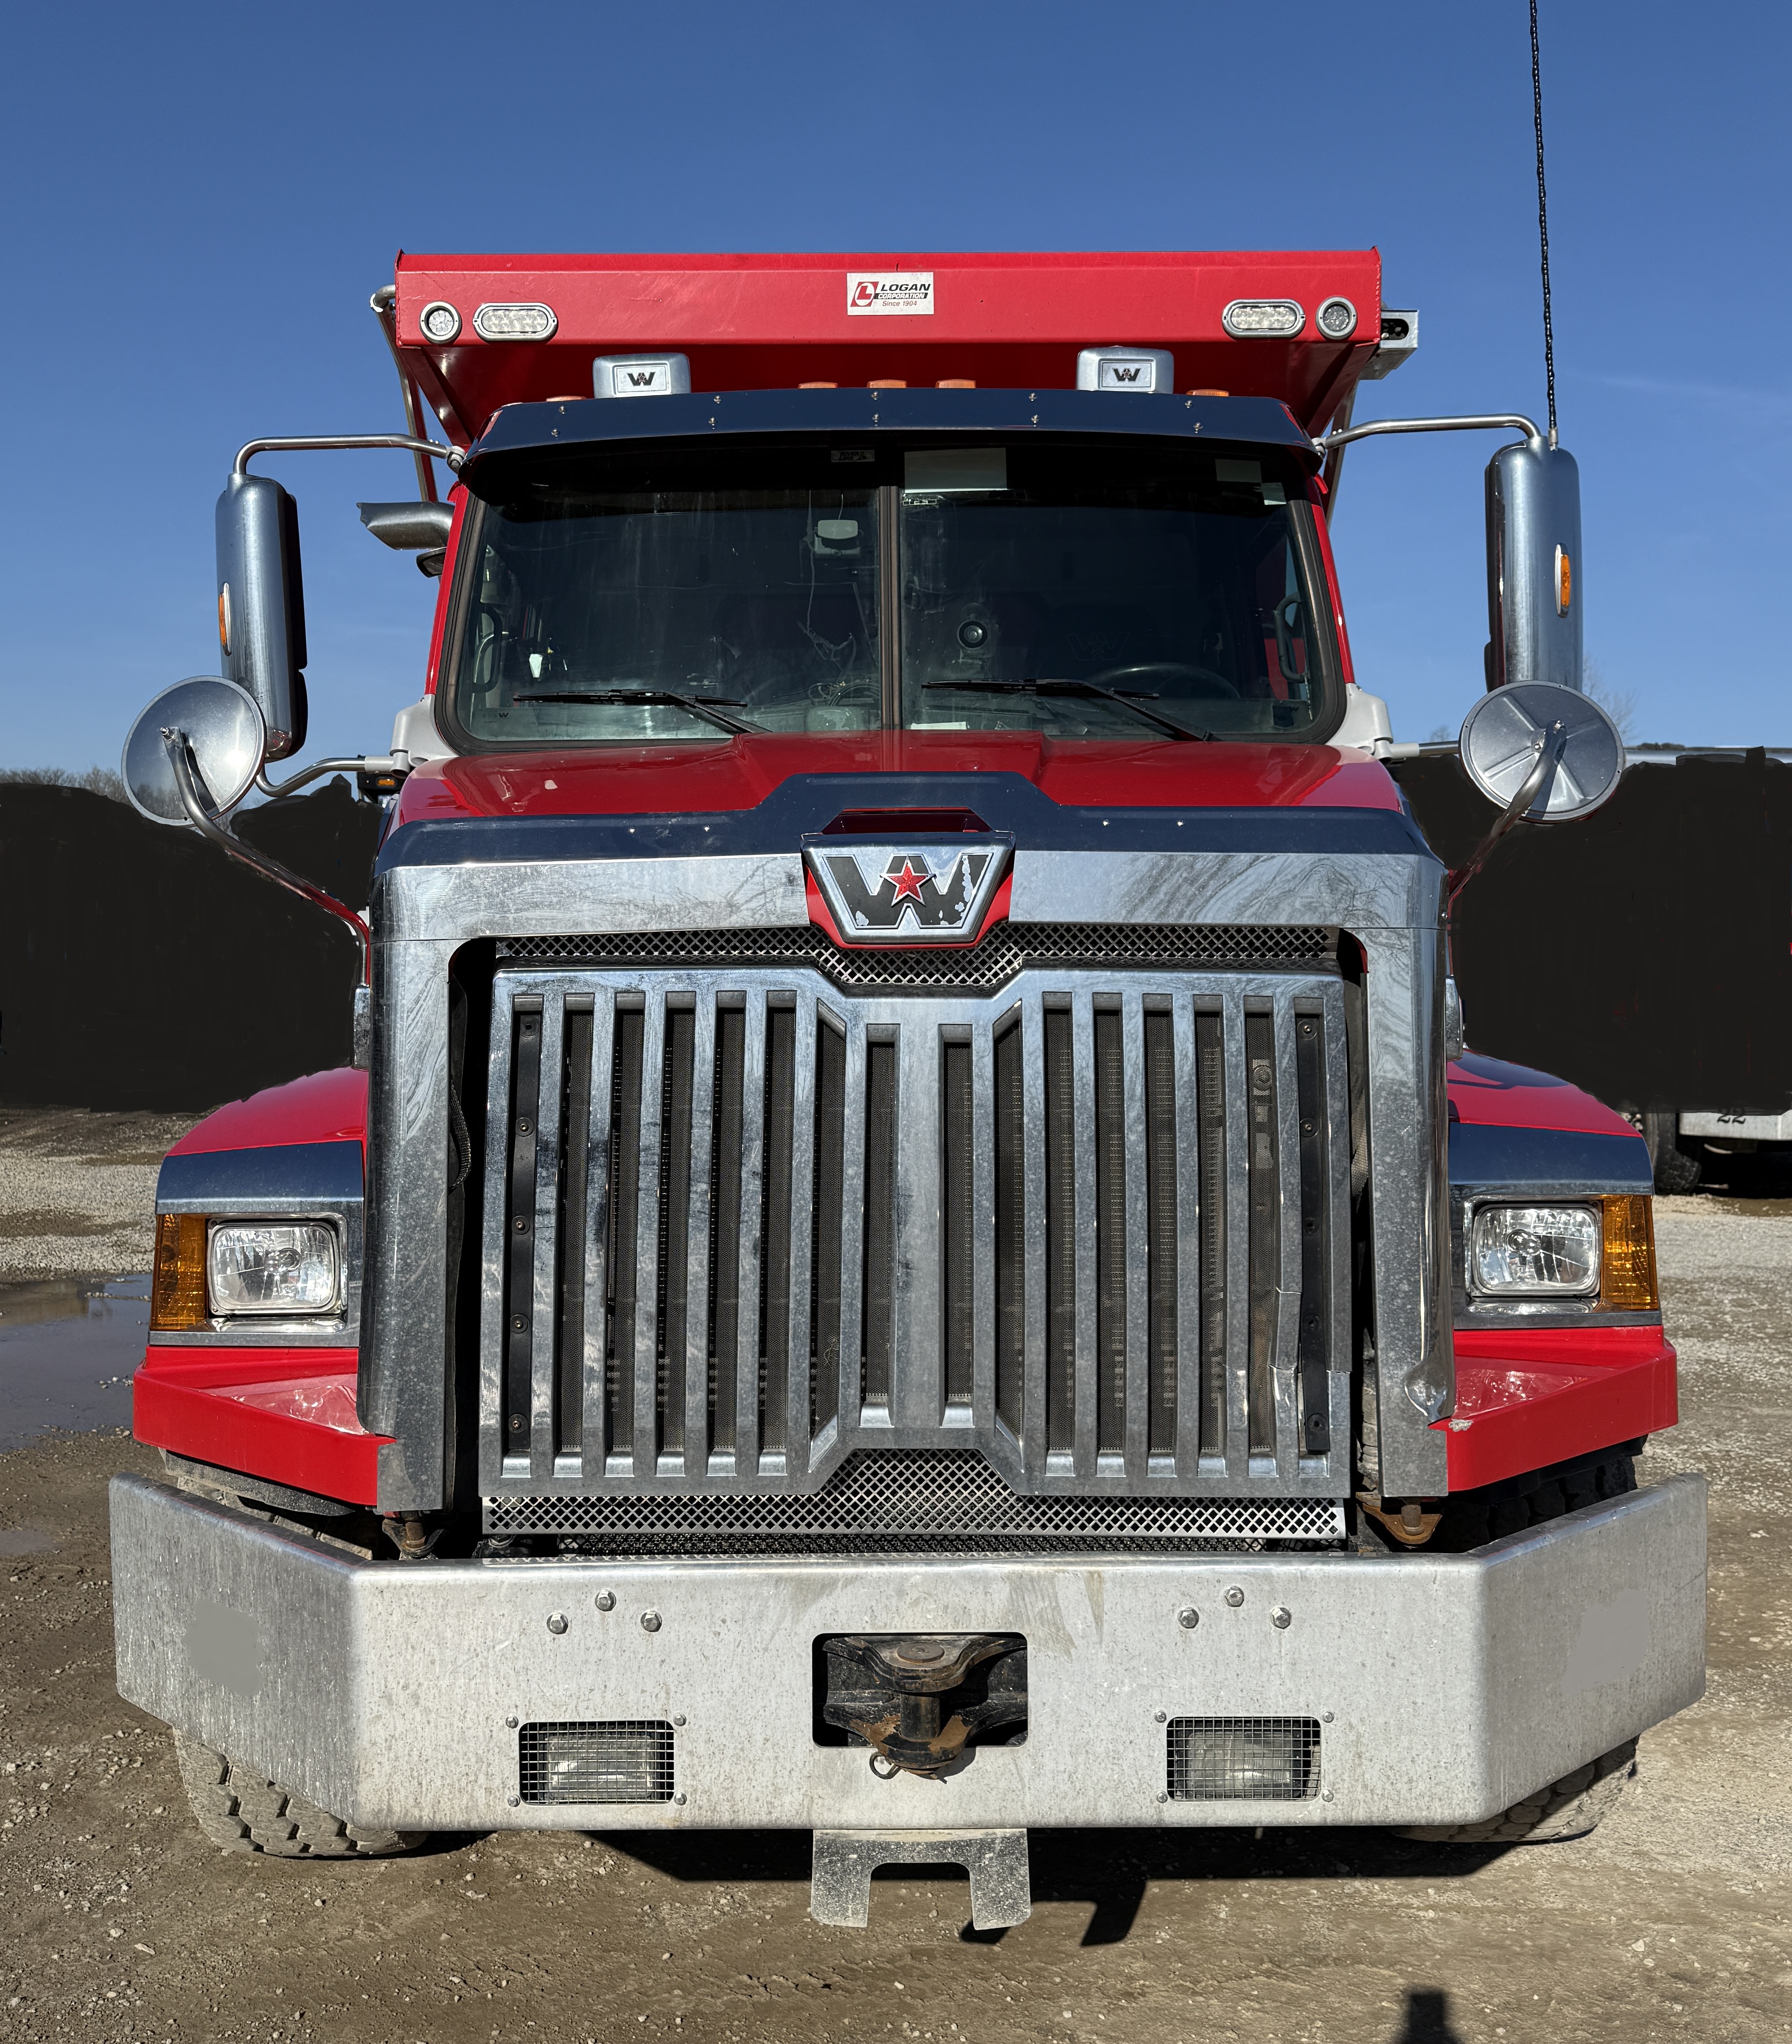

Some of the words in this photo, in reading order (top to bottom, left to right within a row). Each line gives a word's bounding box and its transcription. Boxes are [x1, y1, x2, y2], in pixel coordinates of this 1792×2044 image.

[627, 372, 656, 387] W
[1112, 368, 1142, 382] W
[822, 852, 994, 929] W
